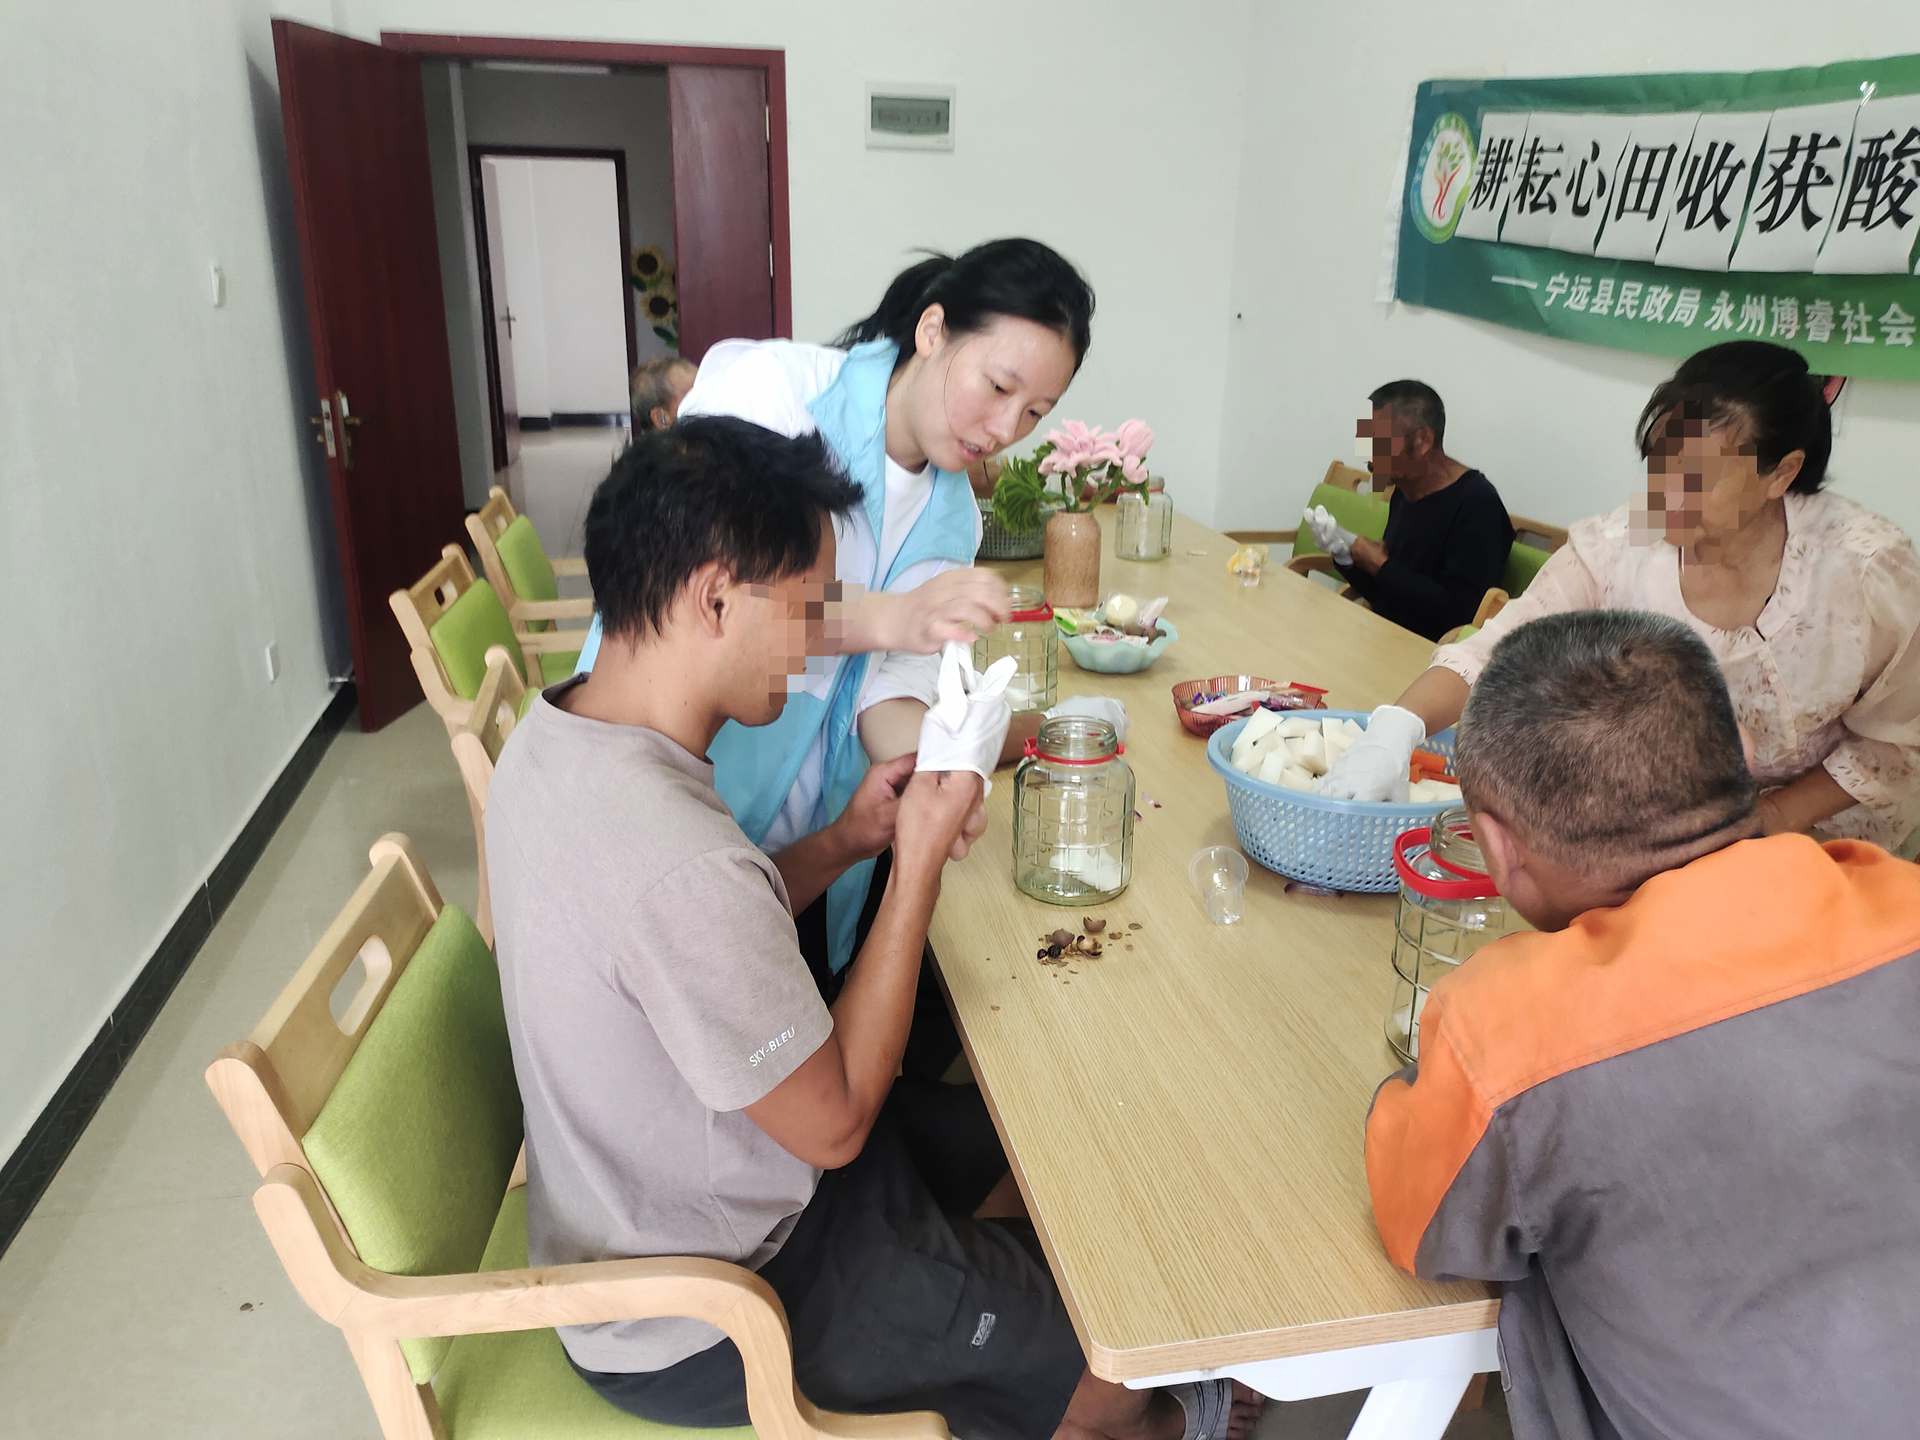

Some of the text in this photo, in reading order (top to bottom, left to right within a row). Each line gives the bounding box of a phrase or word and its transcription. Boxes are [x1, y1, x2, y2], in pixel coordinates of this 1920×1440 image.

[1468, 126, 1920, 233] 耕耘心田收获酸
[749, 1026, 796, 1067] SKY-BLEU
